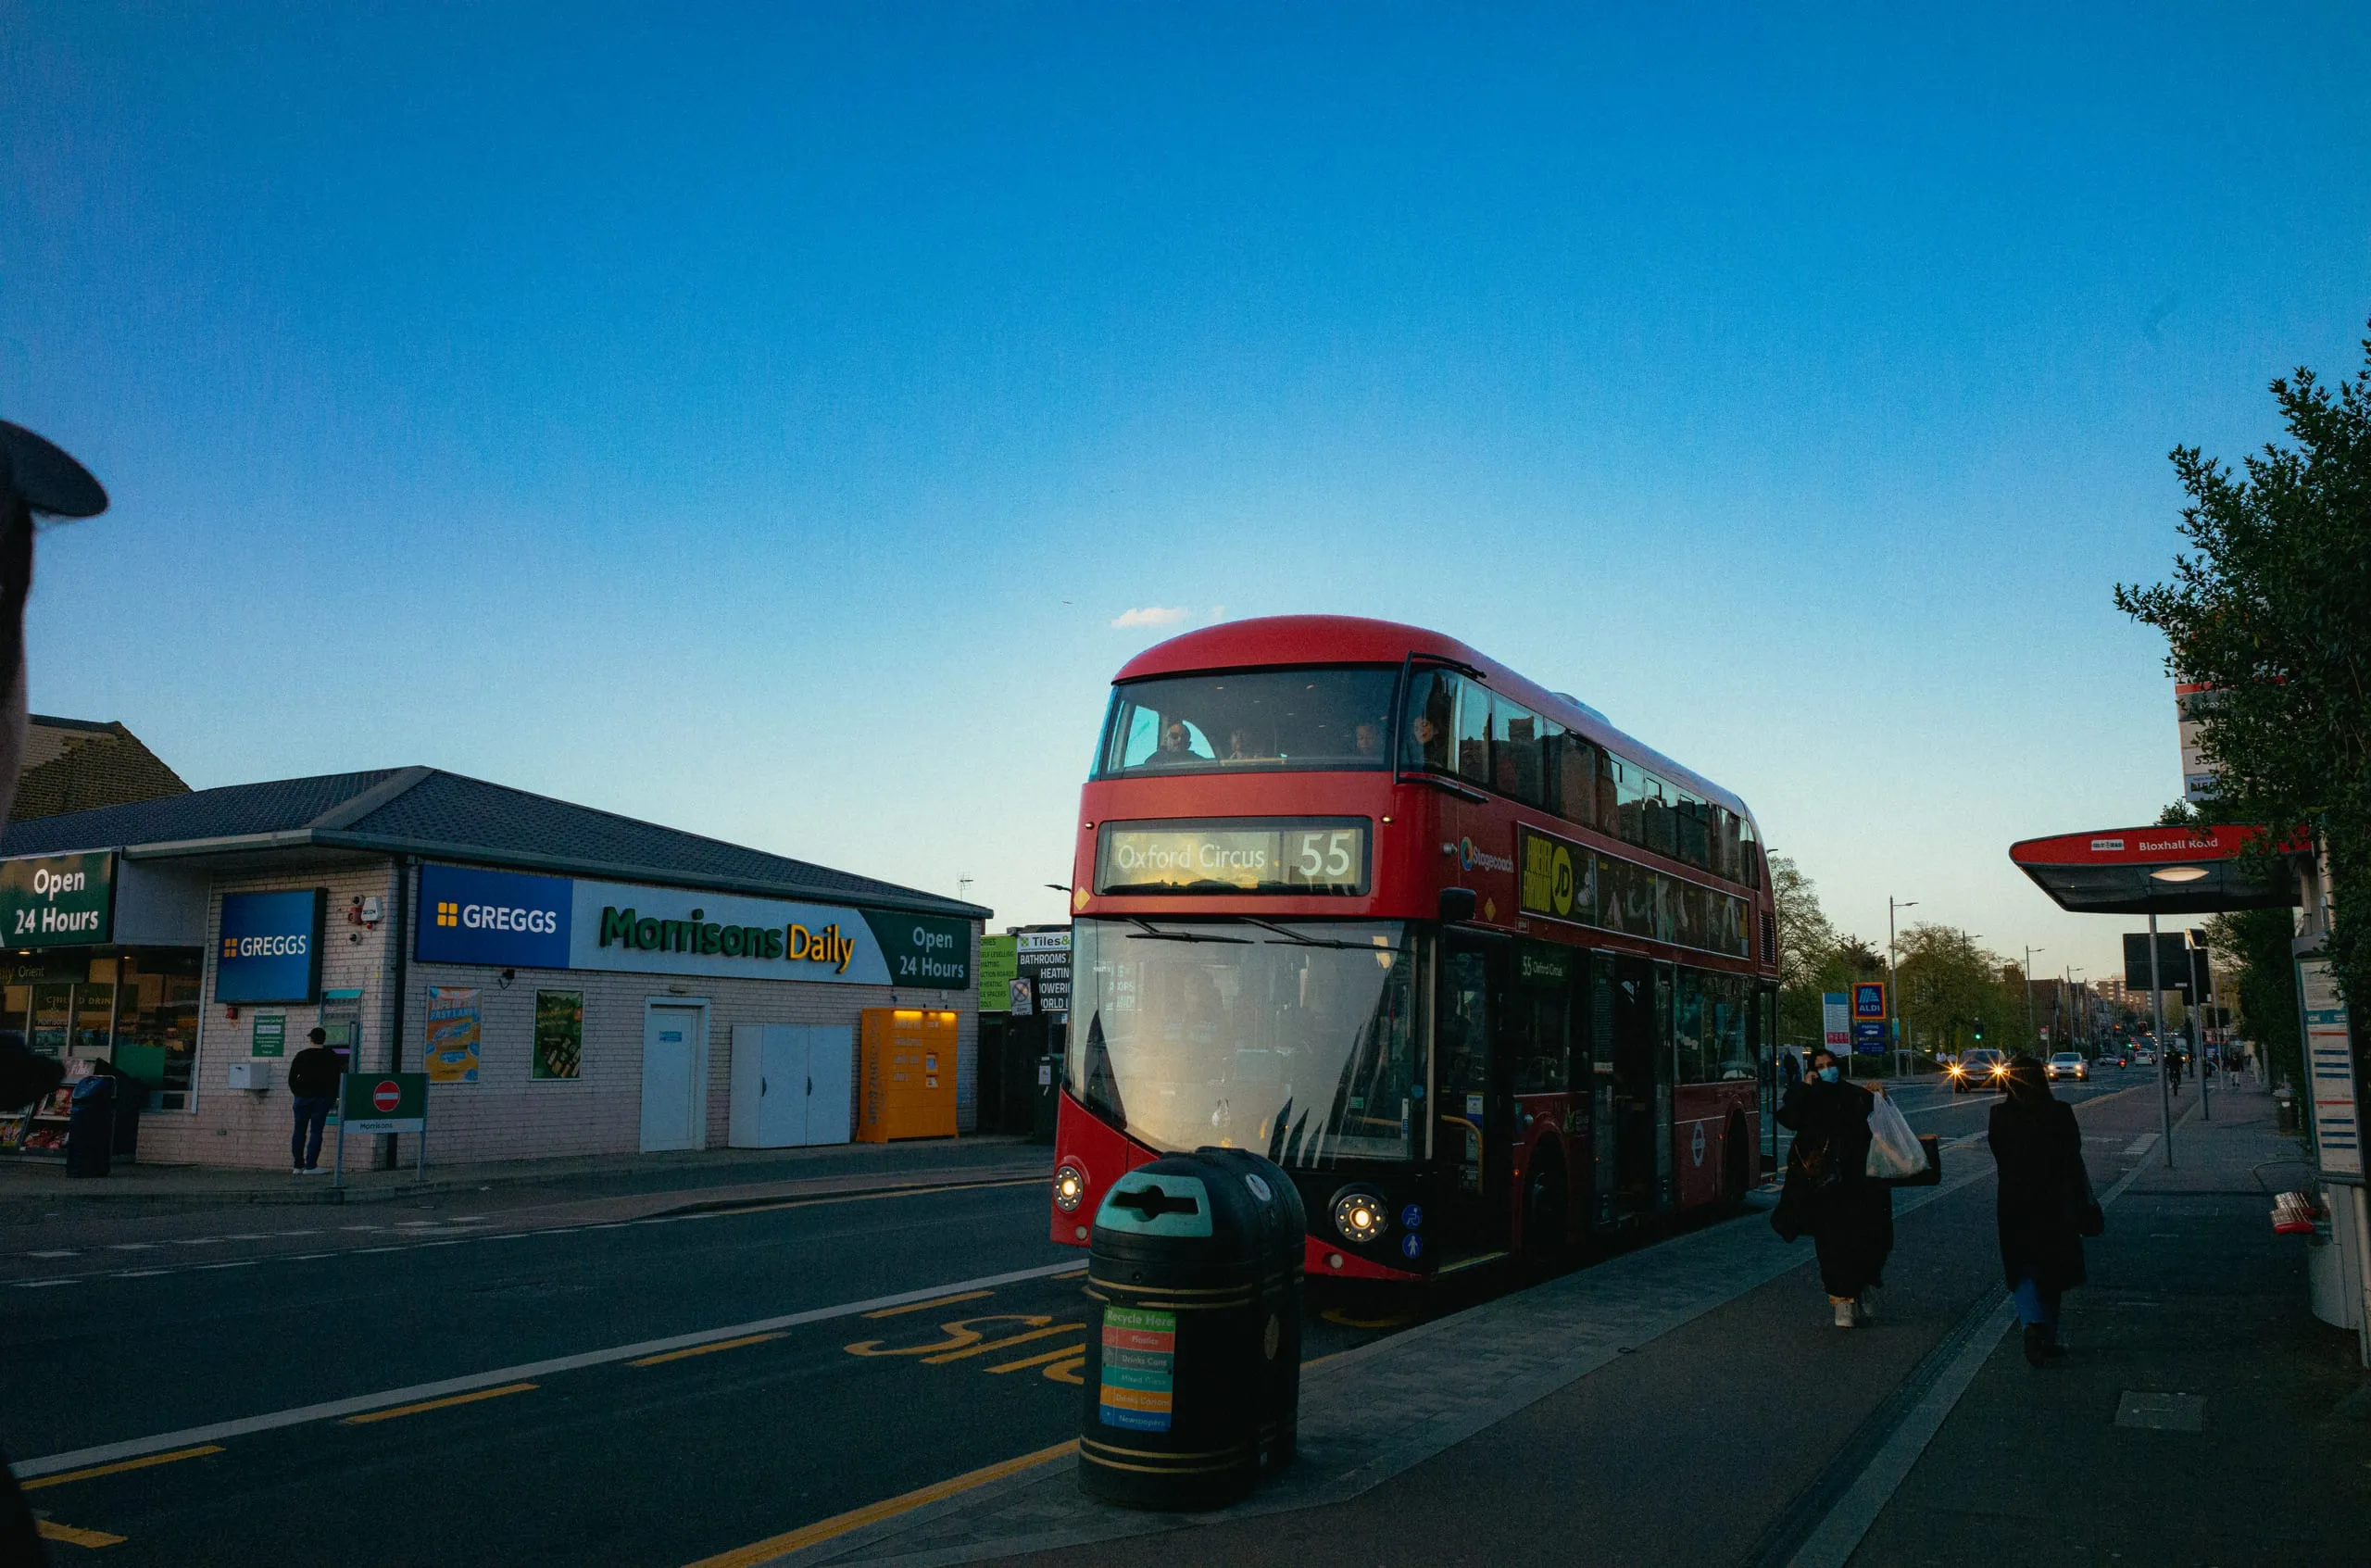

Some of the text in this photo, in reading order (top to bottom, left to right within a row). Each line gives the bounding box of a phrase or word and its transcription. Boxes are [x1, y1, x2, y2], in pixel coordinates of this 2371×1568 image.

[1298, 834, 1350, 875] 55
[2139, 838, 2219, 851] Bloxhall Road
[1118, 844, 1265, 869] Oxford Circus
[1474, 846, 1514, 872] Stagecoach
[33, 868, 85, 901] Open
[15, 907, 99, 935] 24 Hours
[463, 904, 557, 934] GREGGS
[241, 935, 307, 957] GREGGS
[600, 906, 855, 974] Morrisons Daily
[912, 926, 953, 952] Open
[899, 956, 964, 979] 24 Hours
[1020, 953, 1066, 965] BATHROOMS
[1523, 956, 1532, 976] 55
[19, 964, 45, 978] Orient
[360, 1122, 394, 1131] Morrisons
[1107, 1310, 1173, 1327] Recycle Here
[1119, 1414, 1166, 1427] Newspapers
